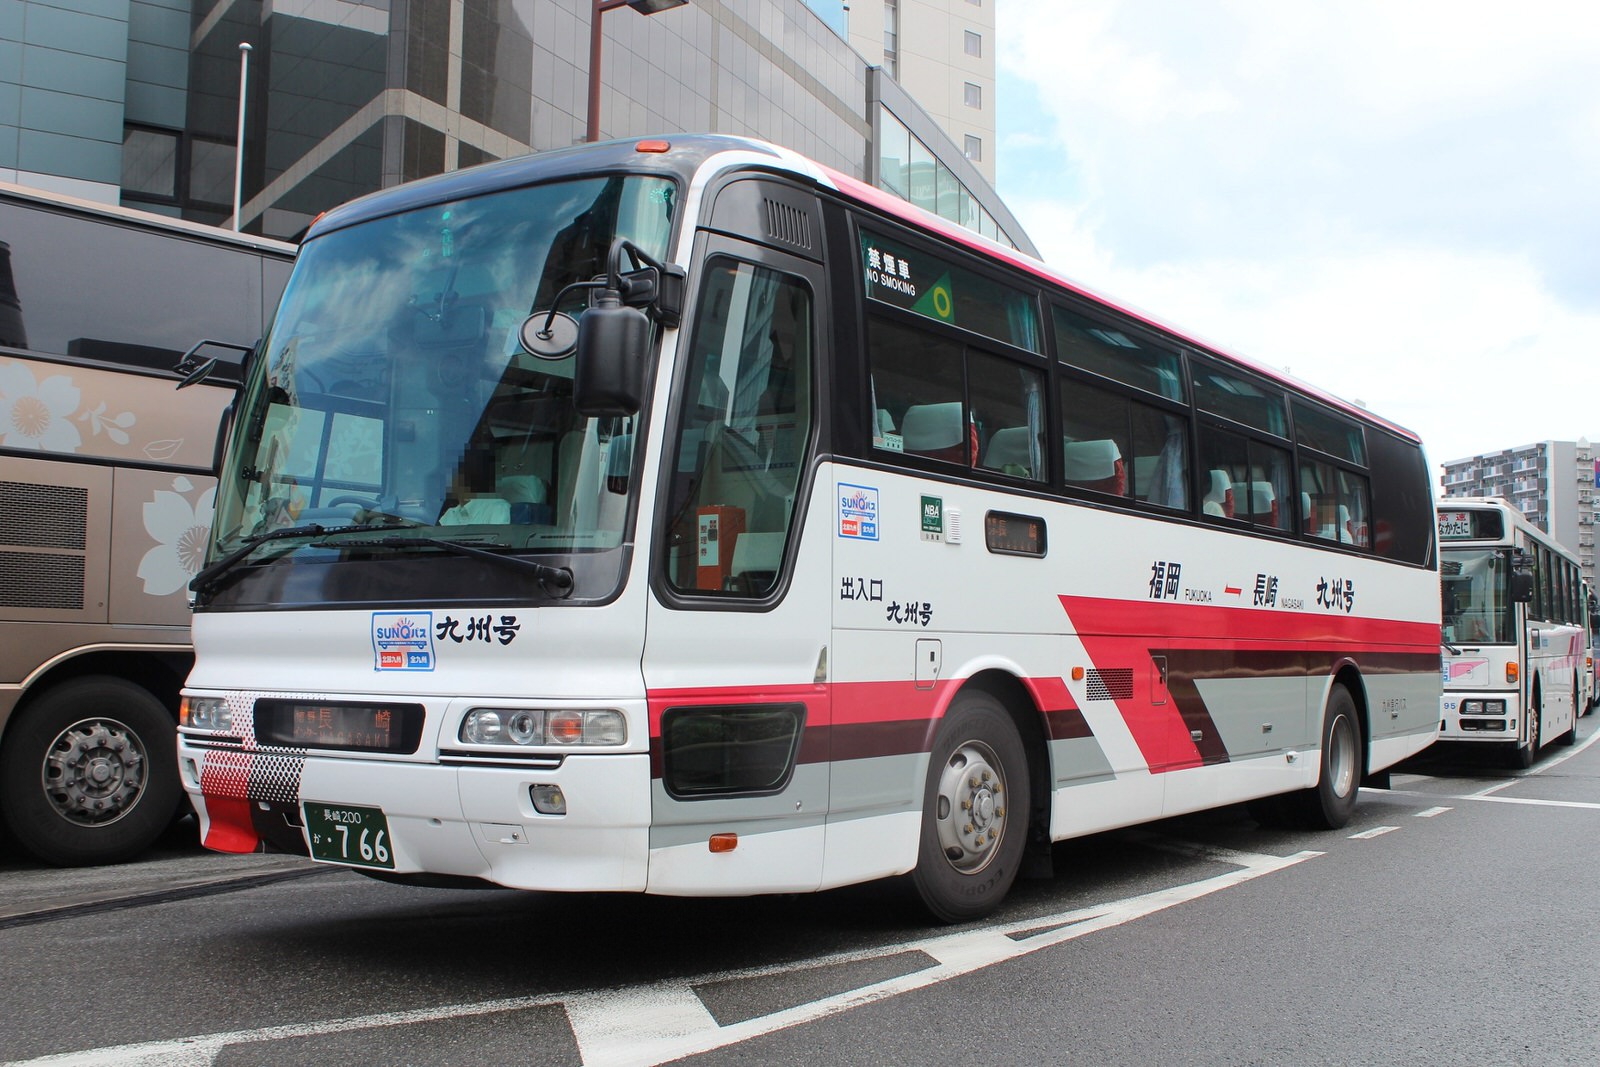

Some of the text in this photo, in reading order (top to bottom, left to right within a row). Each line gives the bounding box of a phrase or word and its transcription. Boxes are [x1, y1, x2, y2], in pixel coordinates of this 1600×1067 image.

[867, 247, 910, 280] 禁煙車
[866, 268, 916, 297] NO SMOKING
[925, 503, 940, 518] NBA
[840, 577, 883, 601] 出入口
[1149, 561, 1181, 600] 福岡
[1185, 588, 1212, 603] FUKUOKA
[1253, 573, 1278, 608] 長崎
[1316, 576, 1354, 613] 九州号
[886, 601, 933, 626] 九州号
[436, 614, 521, 646] 九州号
